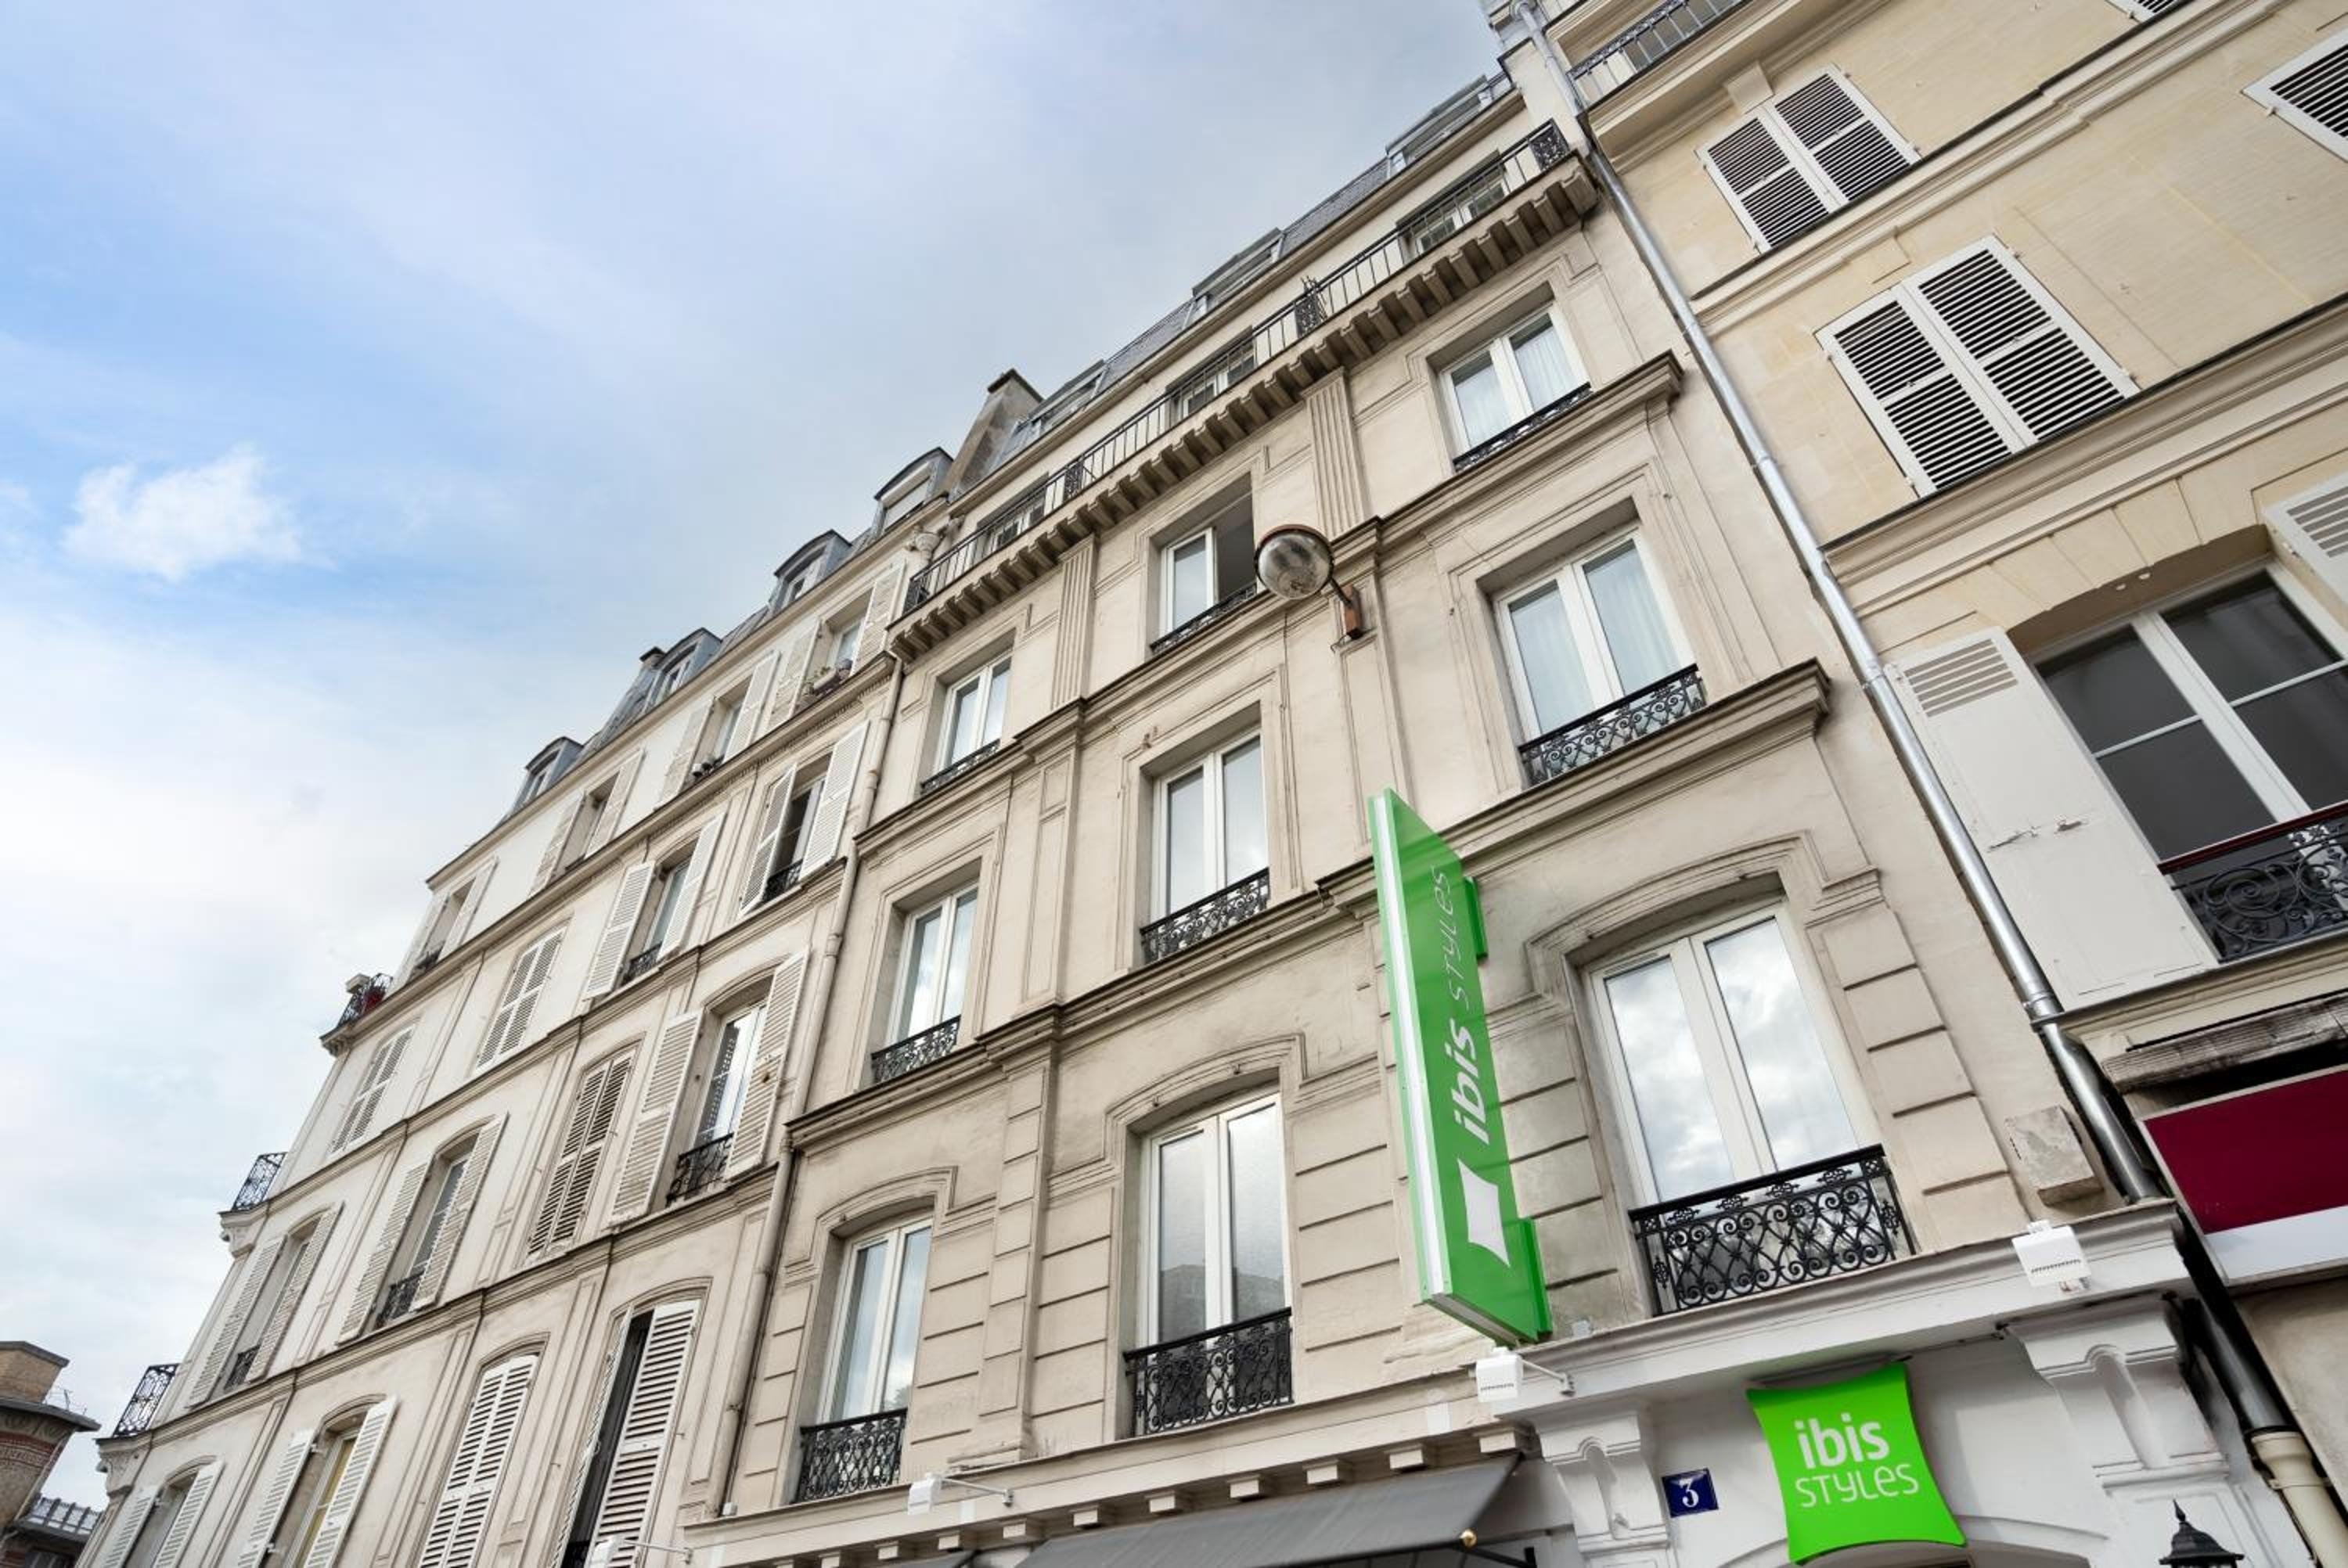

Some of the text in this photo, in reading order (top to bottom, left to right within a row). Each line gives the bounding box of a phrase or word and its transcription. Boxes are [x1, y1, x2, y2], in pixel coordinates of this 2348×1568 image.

[1444, 1019, 1489, 1145] ibis
[1795, 1413, 1889, 1469] ibis
[1679, 1477, 1699, 1508] 3
